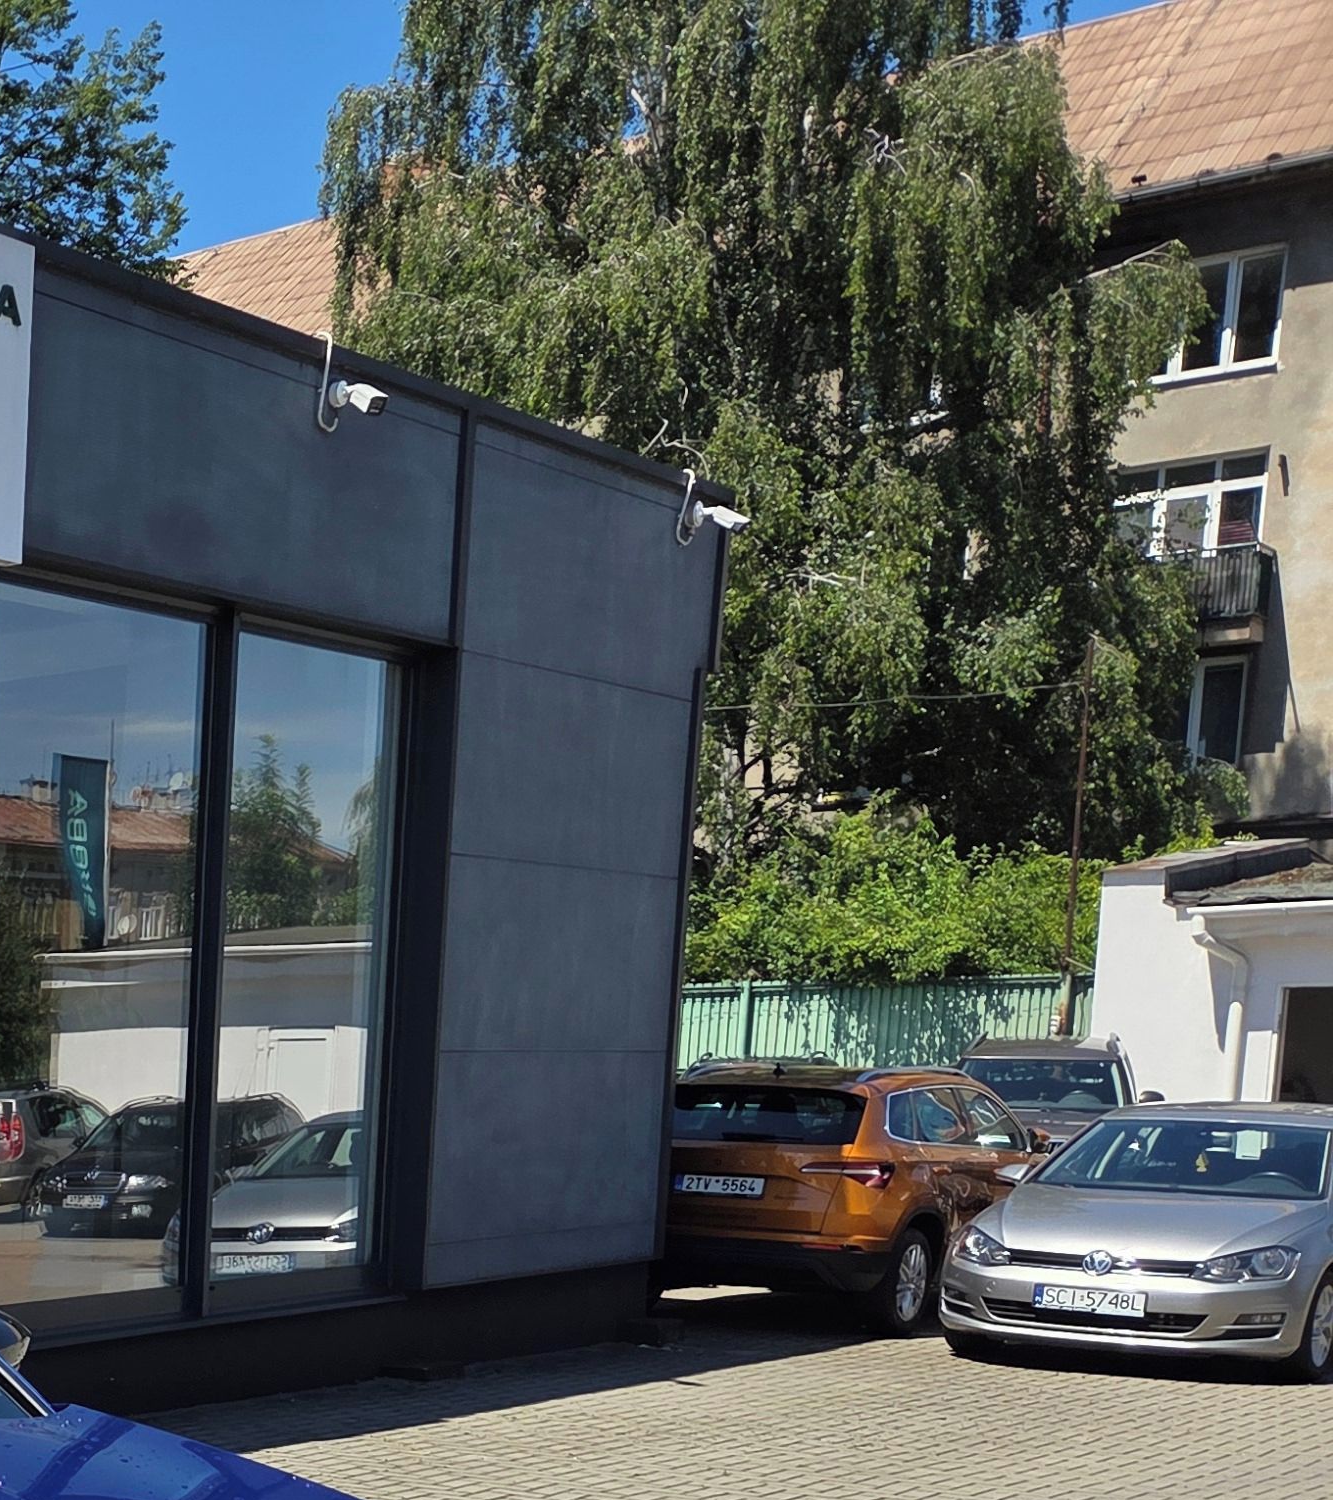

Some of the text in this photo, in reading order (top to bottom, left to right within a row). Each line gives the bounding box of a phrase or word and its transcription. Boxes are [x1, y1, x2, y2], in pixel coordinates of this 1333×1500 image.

[686, 1176, 756, 1192] 2TV 5564
[1044, 1288, 1076, 1306] SCI
[1086, 1291, 1142, 1312] 5748L
